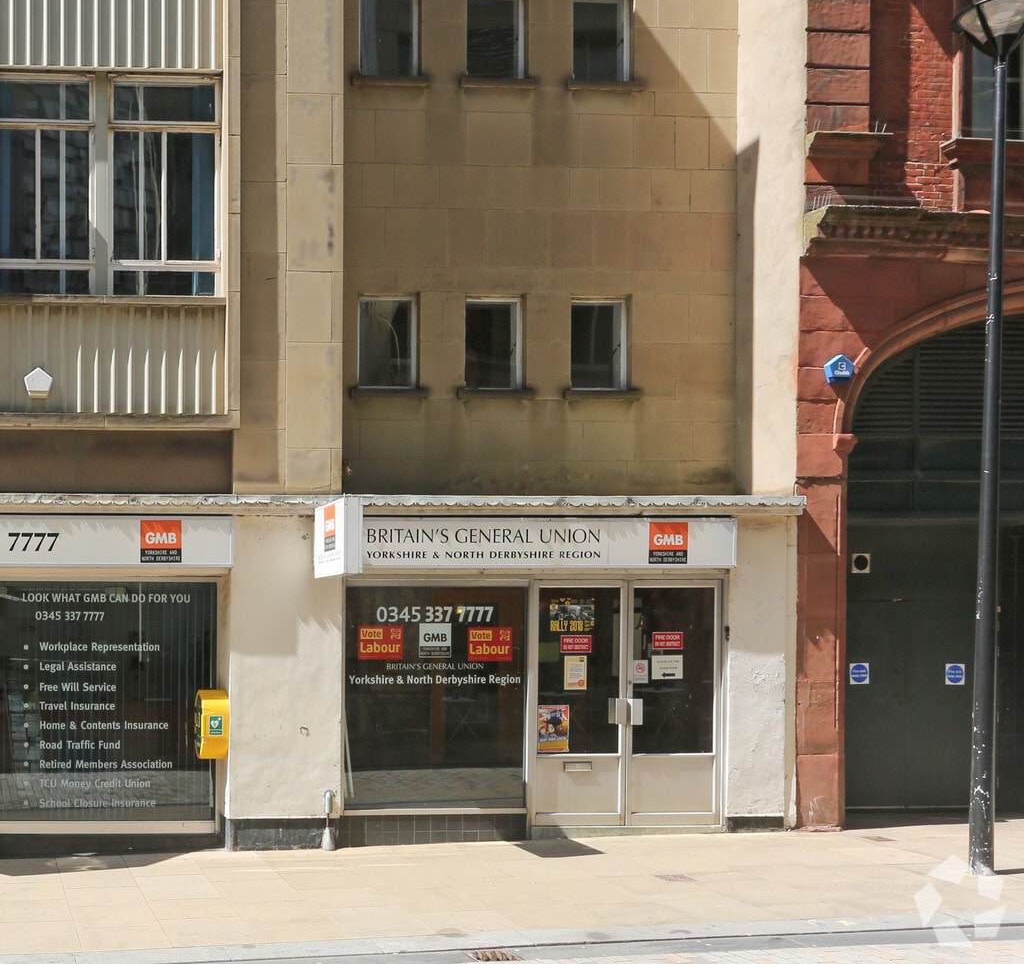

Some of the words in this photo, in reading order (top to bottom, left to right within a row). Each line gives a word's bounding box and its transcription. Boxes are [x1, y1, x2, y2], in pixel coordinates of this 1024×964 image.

[145, 532, 178, 544] GMB
[366, 528, 449, 544] BRITAIN'S
[454, 528, 534, 544] GENERAL
[539, 528, 601, 544] UNION
[654, 534, 684, 546] GMB
[8, 532, 60, 553] 7777
[366, 550, 428, 560] YORKSHIRE
[432, 550, 440, 560] &
[445, 550, 484, 560] NORTH
[489, 550, 554, 560] DERBYSHIRE
[559, 550, 602, 560] REGION
[21, 592, 50, 603] LOOK
[52, 592, 81, 603] WHAT
[83, 592, 106, 603] GMB
[108, 593, 129, 603] CAN
[132, 594, 146, 604] DO
[148, 594, 168, 604] FOR
[170, 594, 191, 604] YOU
[35, 611, 62, 620] 0345
[64, 611, 81, 621] 337
[83, 611, 105, 622] 7777
[376, 606, 422, 623] 0345
[424, 606, 453, 623] 337
[456, 606, 494, 623] 7777
[550, 620, 568, 632] RALLY
[570, 620, 584, 632] 2018
[361, 629, 382, 639] Vote
[423, 633, 448, 642] GMB
[471, 630, 491, 640] Vote
[39, 642, 88, 654] Workplace
[91, 642, 160, 654] Representation
[360, 642, 401, 653] Labour
[469, 643, 510, 655] Labour
[39, 662, 65, 674] Legal
[67, 662, 116, 672] Assistance
[386, 662, 422, 671] BRITAIN'S
[422, 662, 456, 670] GENERAL
[458, 662, 484, 670] UNION
[348, 674, 394, 685] Yorkshire
[396, 675, 404, 685] &
[406, 675, 433, 685] North
[435, 674, 487, 687] Derbyshire
[488, 674, 522, 687] Region
[39, 682, 58, 692] Free
[61, 682, 80, 692] Will
[82, 682, 116, 692] Service
[39, 700, 68, 711] Travel
[70, 700, 116, 711] Insurance
[40, 720, 66, 730] Home
[70, 720, 77, 730] &
[80, 720, 121, 730] Contents
[124, 720, 169, 730] Insurance
[40, 740, 62, 750] Road
[66, 740, 96, 750] Traffic
[98, 740, 121, 750] Fund
[40, 760, 72, 770] Retired
[75, 760, 118, 770] Members
[120, 760, 173, 770] Association
[39, 778, 57, 788] TCU
[60, 778, 92, 790] Money
[94, 778, 122, 788] Credit
[124, 778, 151, 788] Union
[39, 798, 71, 808] School
[74, 798, 108, 808] Closure
[111, 798, 156, 808] Insurance
